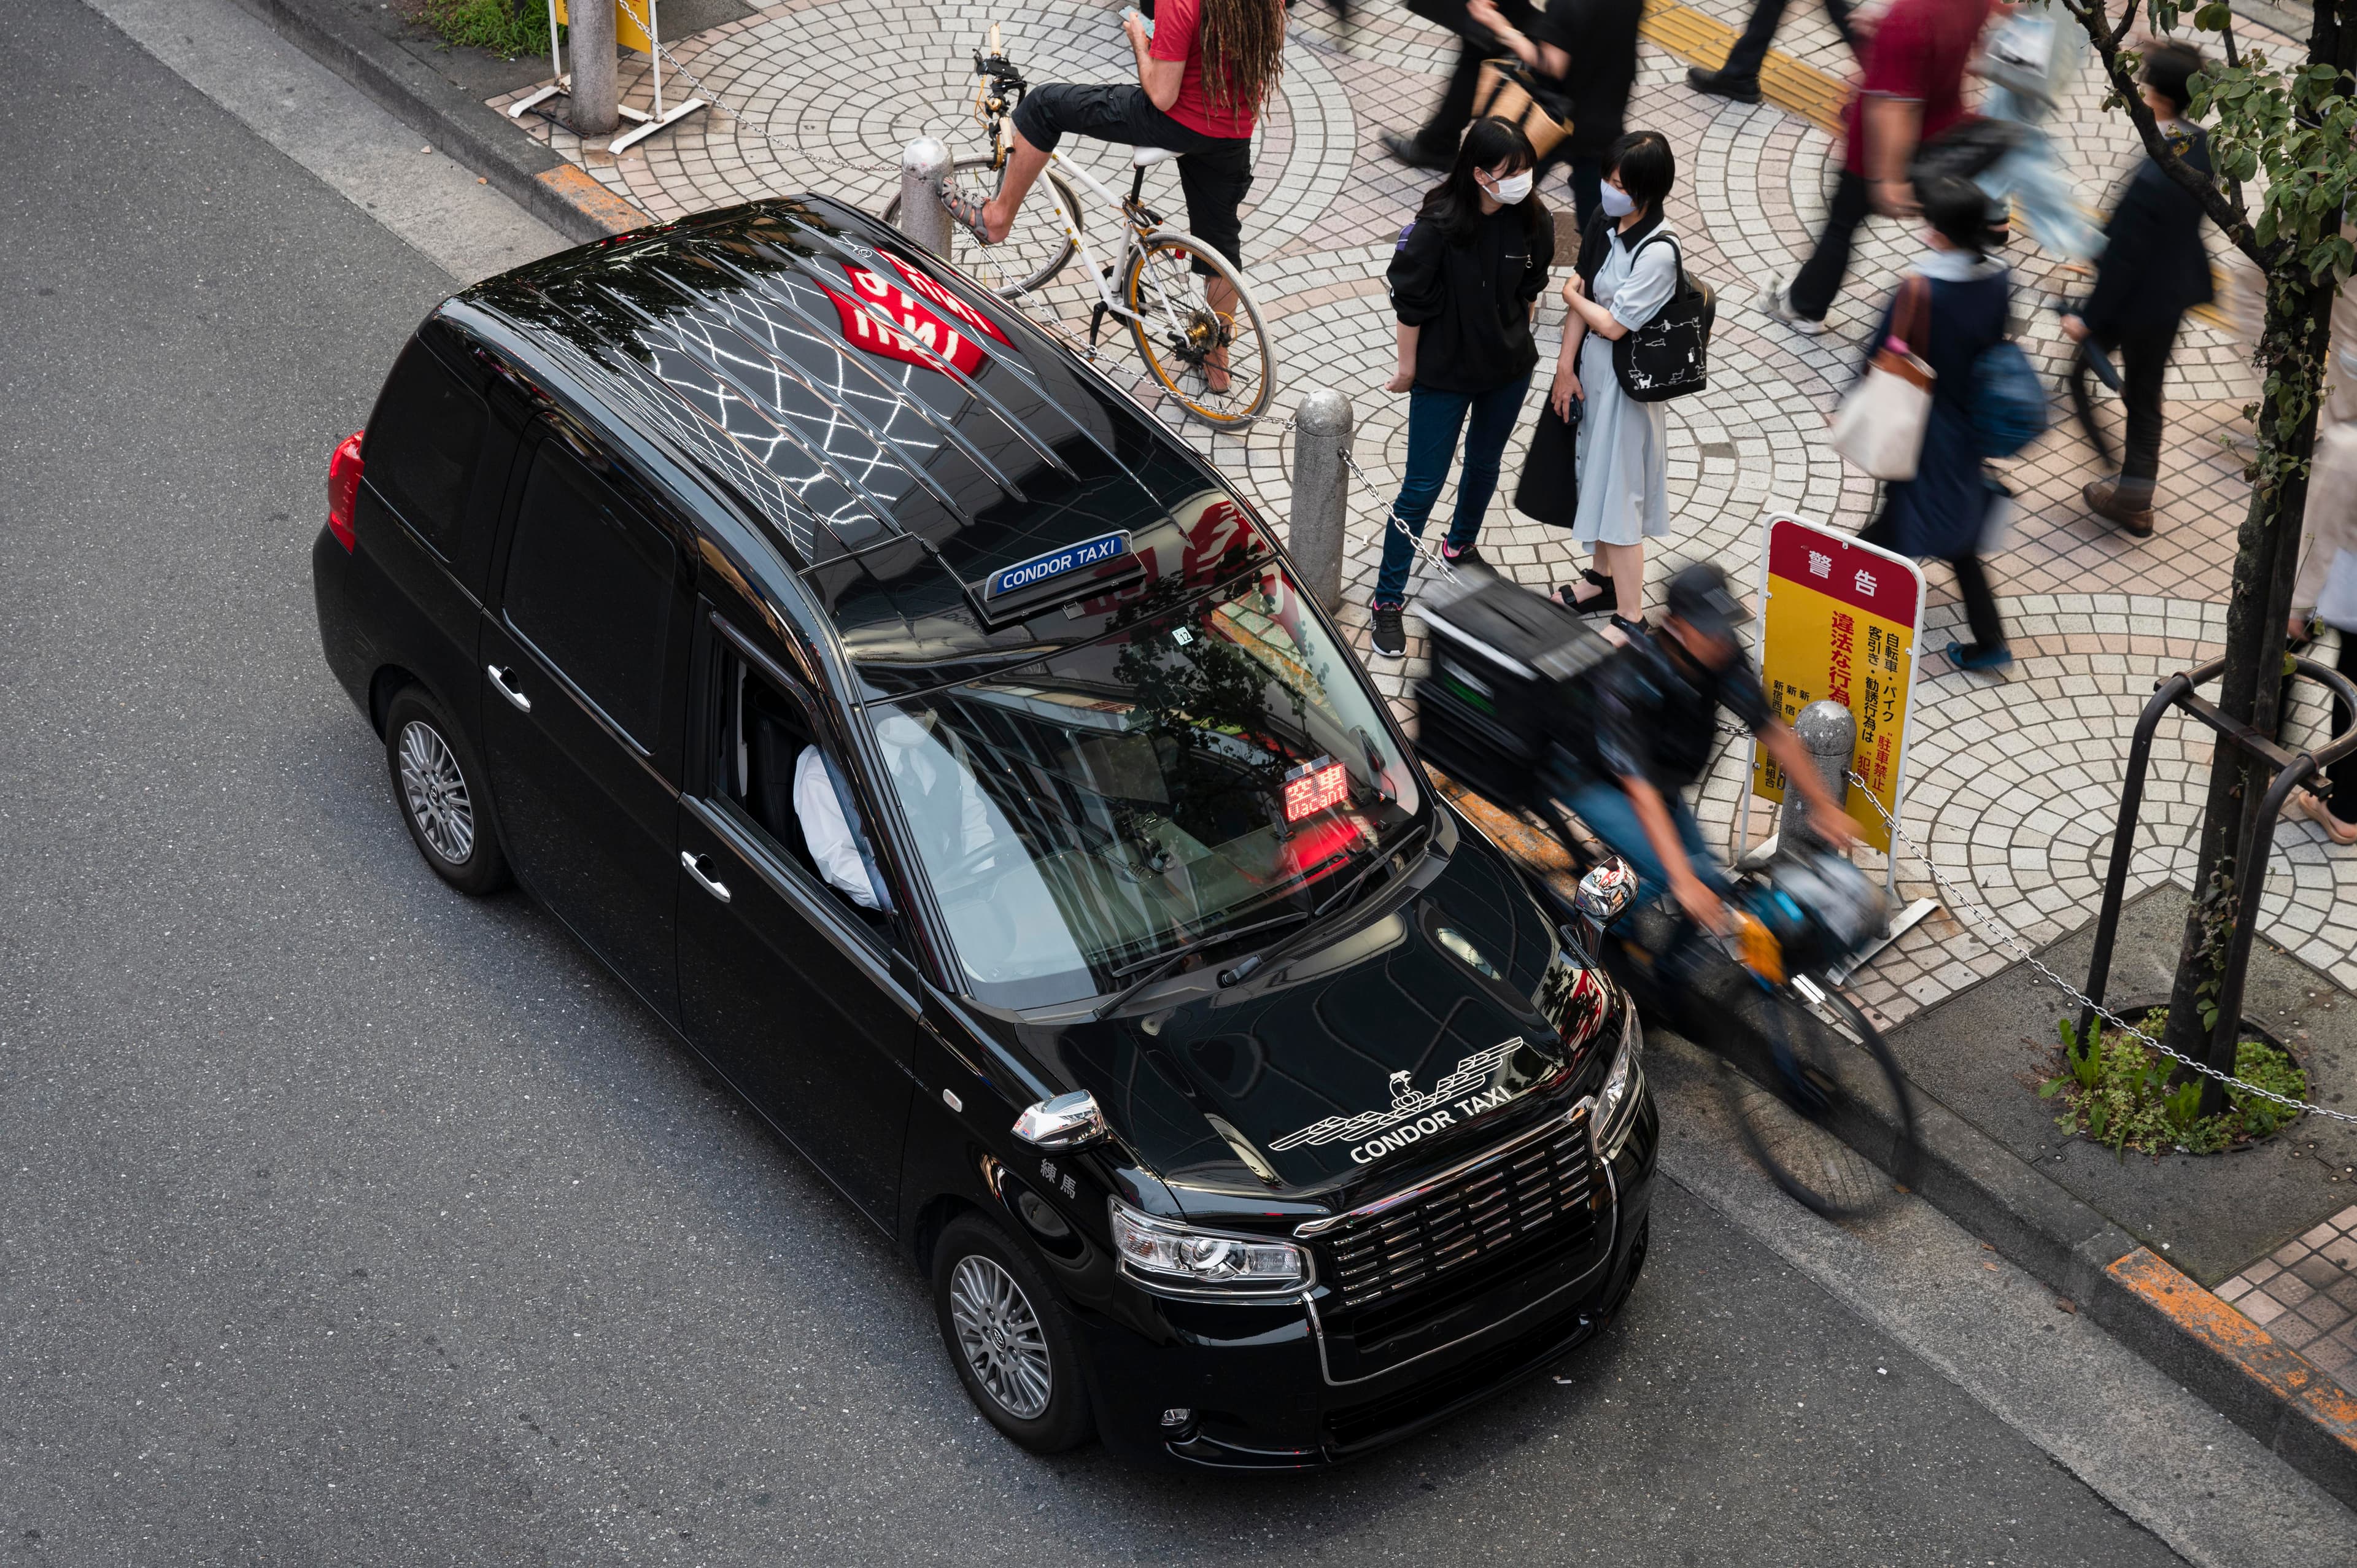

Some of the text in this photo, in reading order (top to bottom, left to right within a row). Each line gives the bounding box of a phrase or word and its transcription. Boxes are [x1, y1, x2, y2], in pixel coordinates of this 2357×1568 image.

[1003, 539, 1115, 589] CONDOR TAXI
[1808, 550, 1878, 597] 警告
[1180, 631, 1192, 642] 12
[1828, 610, 1854, 708] 違法な行為
[1862, 625, 1883, 743] 客引き・勧誘行為は
[1883, 633, 1899, 722] 自転車・バイク
[1288, 765, 1343, 805] 空車
[1288, 785, 1345, 820] Vacant
[1350, 1085, 1513, 1164] CONDOR TAXI
[1040, 1158, 1077, 1199] 練馬
